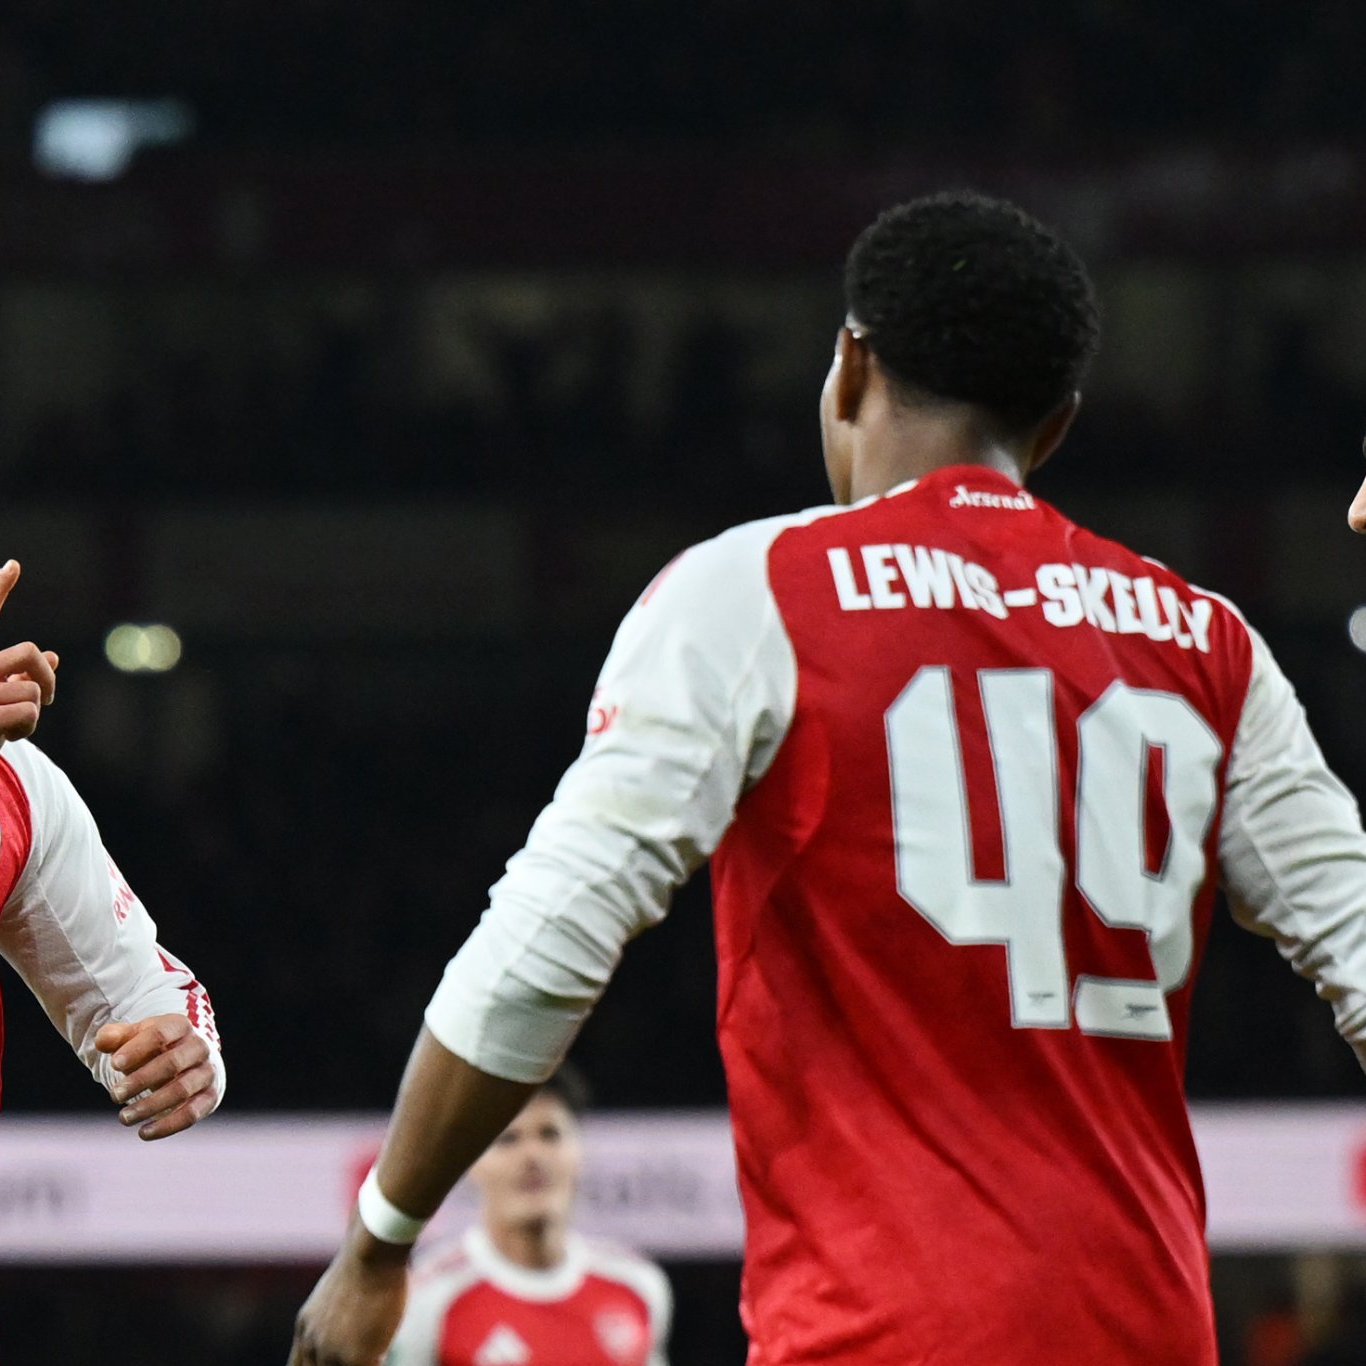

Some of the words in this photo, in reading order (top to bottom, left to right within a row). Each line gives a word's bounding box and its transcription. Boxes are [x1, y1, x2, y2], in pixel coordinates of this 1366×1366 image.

[949, 485, 1037, 511] Arsenal
[826, 543, 1212, 654] LEWIS-SKELLY
[883, 664, 1225, 1043] 49
